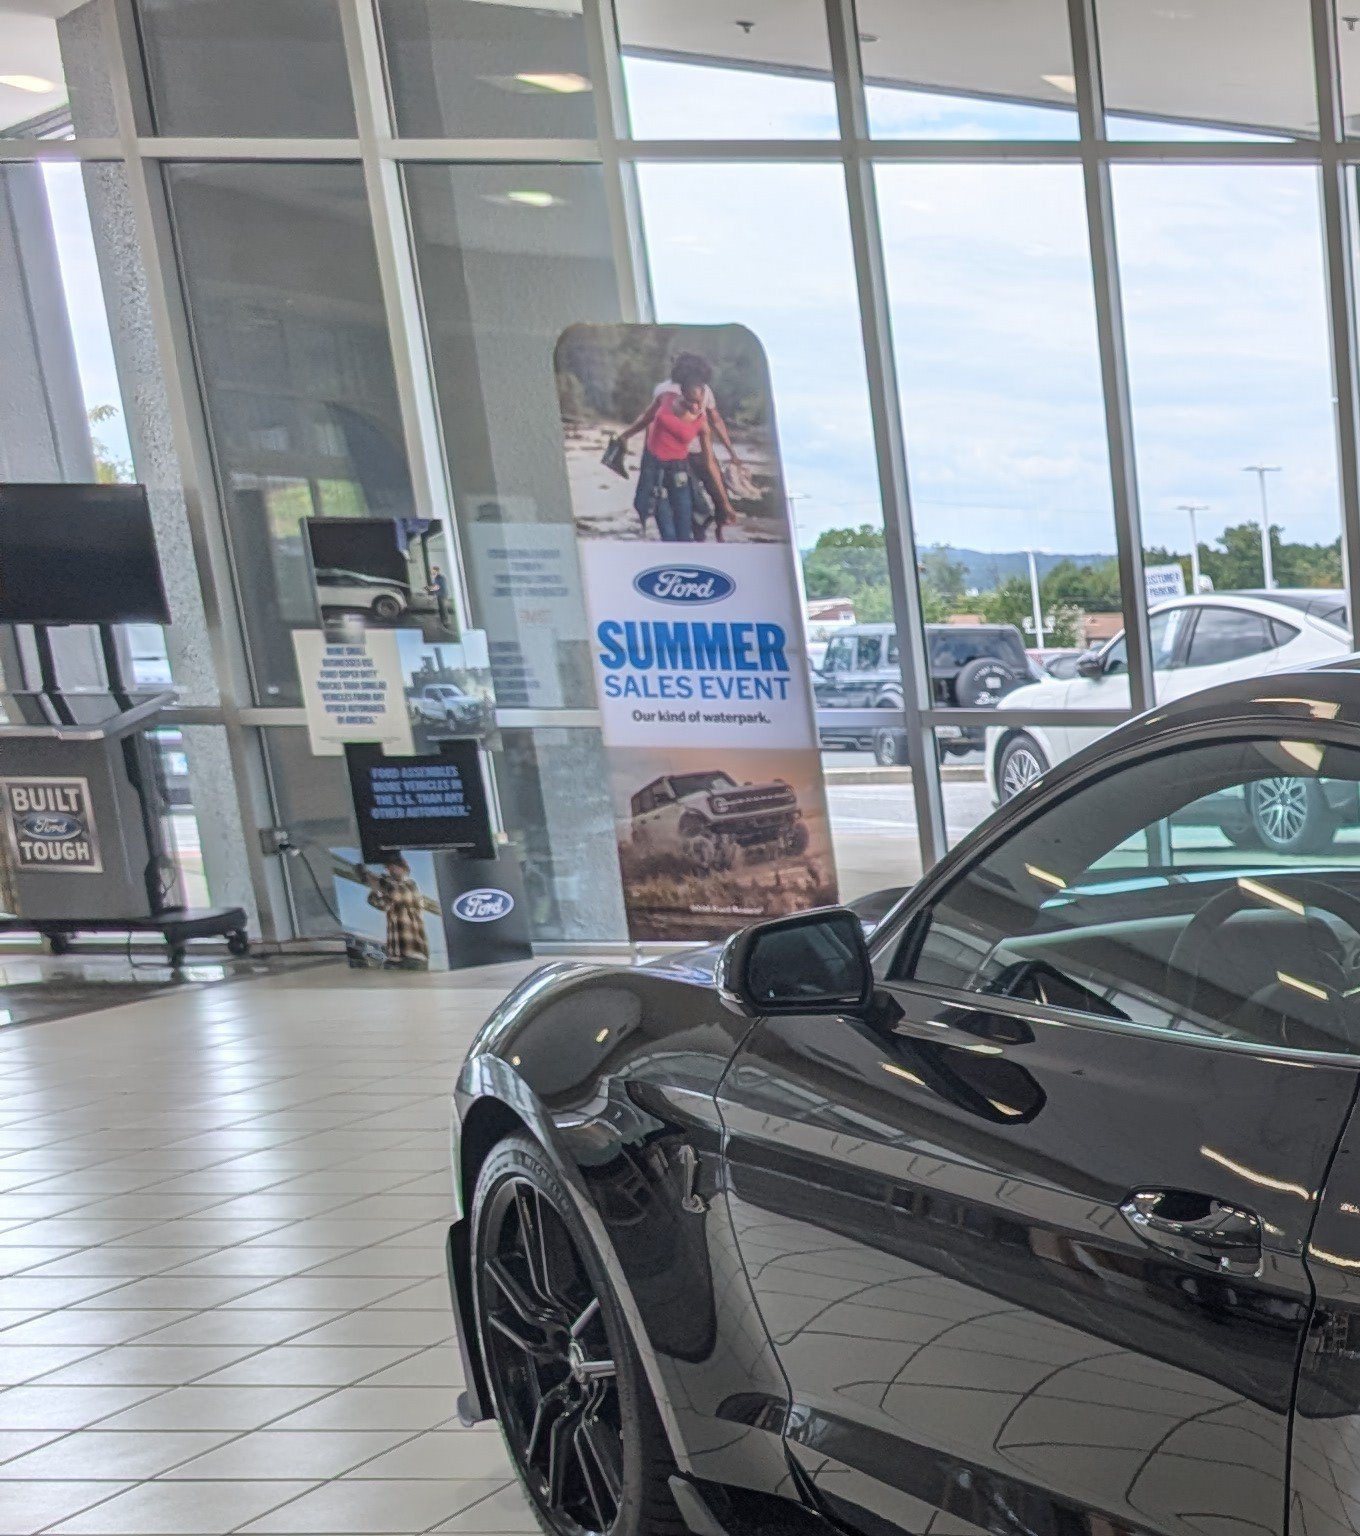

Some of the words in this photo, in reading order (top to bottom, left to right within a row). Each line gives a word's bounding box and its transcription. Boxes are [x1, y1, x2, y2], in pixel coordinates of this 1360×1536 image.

[653, 570, 715, 598] Ford
[597, 620, 790, 671] SUMMER
[604, 674, 694, 699] SALES
[699, 676, 791, 701] EVENT
[632, 709, 656, 723] Our
[657, 710, 686, 723] kind
[688, 710, 700, 723] of
[11, 787, 80, 811] BUILT
[20, 841, 90, 861] TOUGH
[464, 893, 504, 917] Ford
